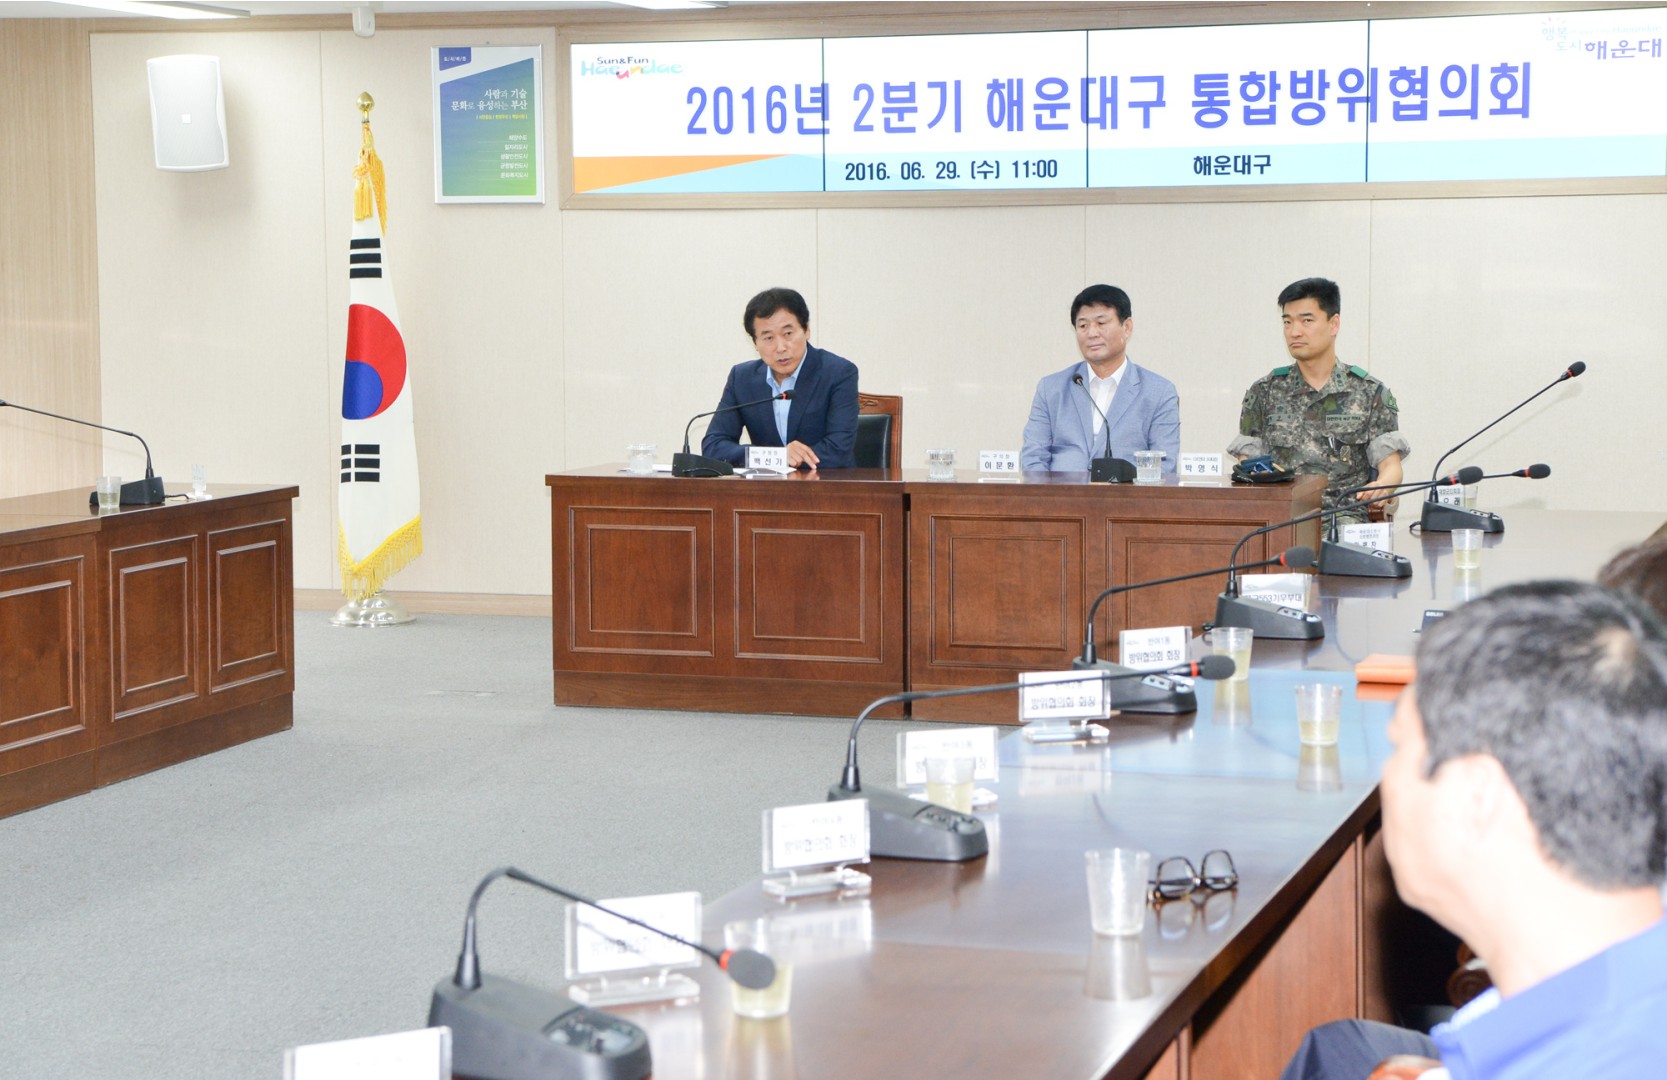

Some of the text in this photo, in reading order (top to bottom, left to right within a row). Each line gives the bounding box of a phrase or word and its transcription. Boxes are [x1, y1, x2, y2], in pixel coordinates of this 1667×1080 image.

[1584, 38, 1662, 60] 해운대
[581, 60, 684, 80] Haeundae
[597, 56, 649, 65] Sun&Fun
[484, 88, 528, 100] 사람과 기술
[686, 61, 1531, 135] 2016년 2분기 해운대구 통합방위협의회
[451, 100, 528, 111] 문화로 융성하는 부산
[845, 161, 891, 181] 2016.
[900, 161, 925, 180] 06.
[935, 161, 961, 180] 29.
[1011, 159, 1058, 178] 11:00
[1193, 154, 1272, 176] 해운대구
